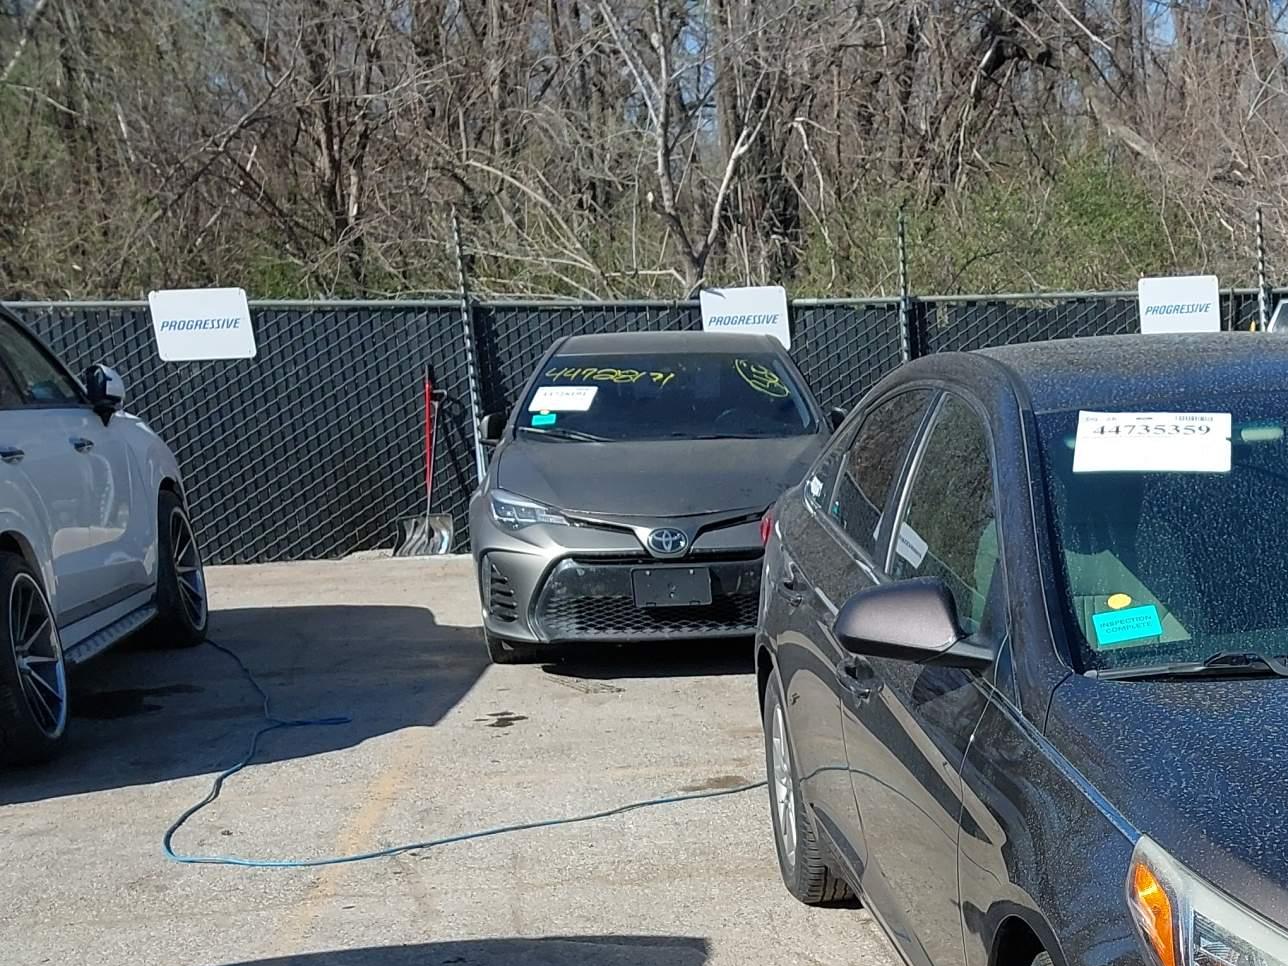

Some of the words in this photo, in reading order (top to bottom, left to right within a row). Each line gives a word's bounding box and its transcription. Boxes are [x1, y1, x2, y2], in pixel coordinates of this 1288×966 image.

[1145, 303, 1211, 315] PROGRESSIVE
[160, 318, 241, 332] PROGRESSIVE
[709, 314, 780, 327] PROGRESSIVE
[1093, 424, 1211, 436] 44735359
[1100, 615, 1152, 629] INSPECTION
[1105, 621, 1153, 634] COMPLETE
